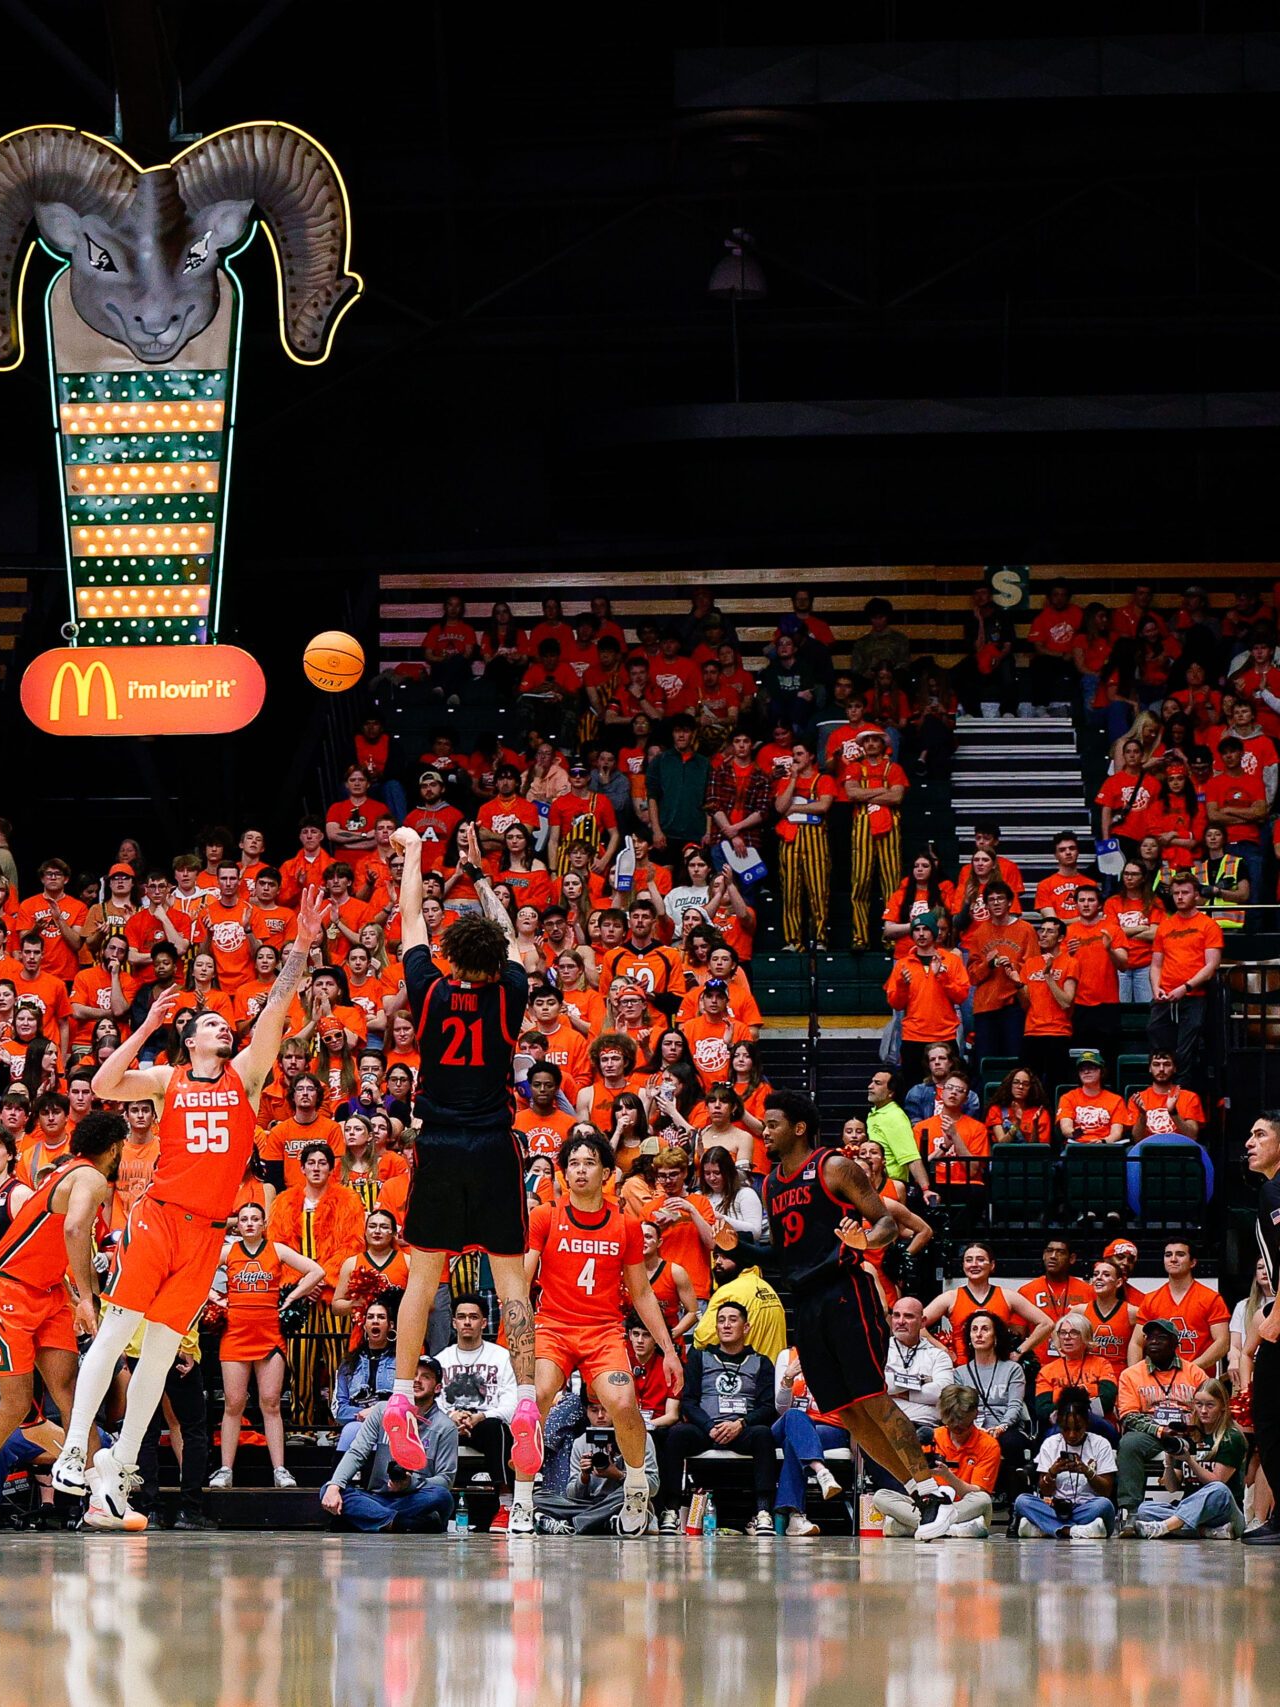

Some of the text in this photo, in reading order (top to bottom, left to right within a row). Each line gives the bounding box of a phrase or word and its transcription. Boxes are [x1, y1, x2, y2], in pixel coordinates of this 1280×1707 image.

[991, 571, 1023, 608] S
[128, 679, 231, 699] i'm lovin' it
[421, 826, 439, 843] A
[675, 897, 707, 908] COLORA
[439, 1016, 485, 1066] 21
[545, 1051, 568, 1066] GIES
[173, 1090, 239, 1109] AGGIES
[185, 1111, 229, 1153] 55
[535, 1135, 549, 1147] A
[772, 1186, 812, 1216] AZTECS
[558, 1238, 620, 1256] AGGIES
[233, 1270, 273, 1284] Aggies
[577, 1258, 596, 1295] 4
[1093, 1335, 1124, 1347] ggies
[1176, 1329, 1197, 1341] gies
